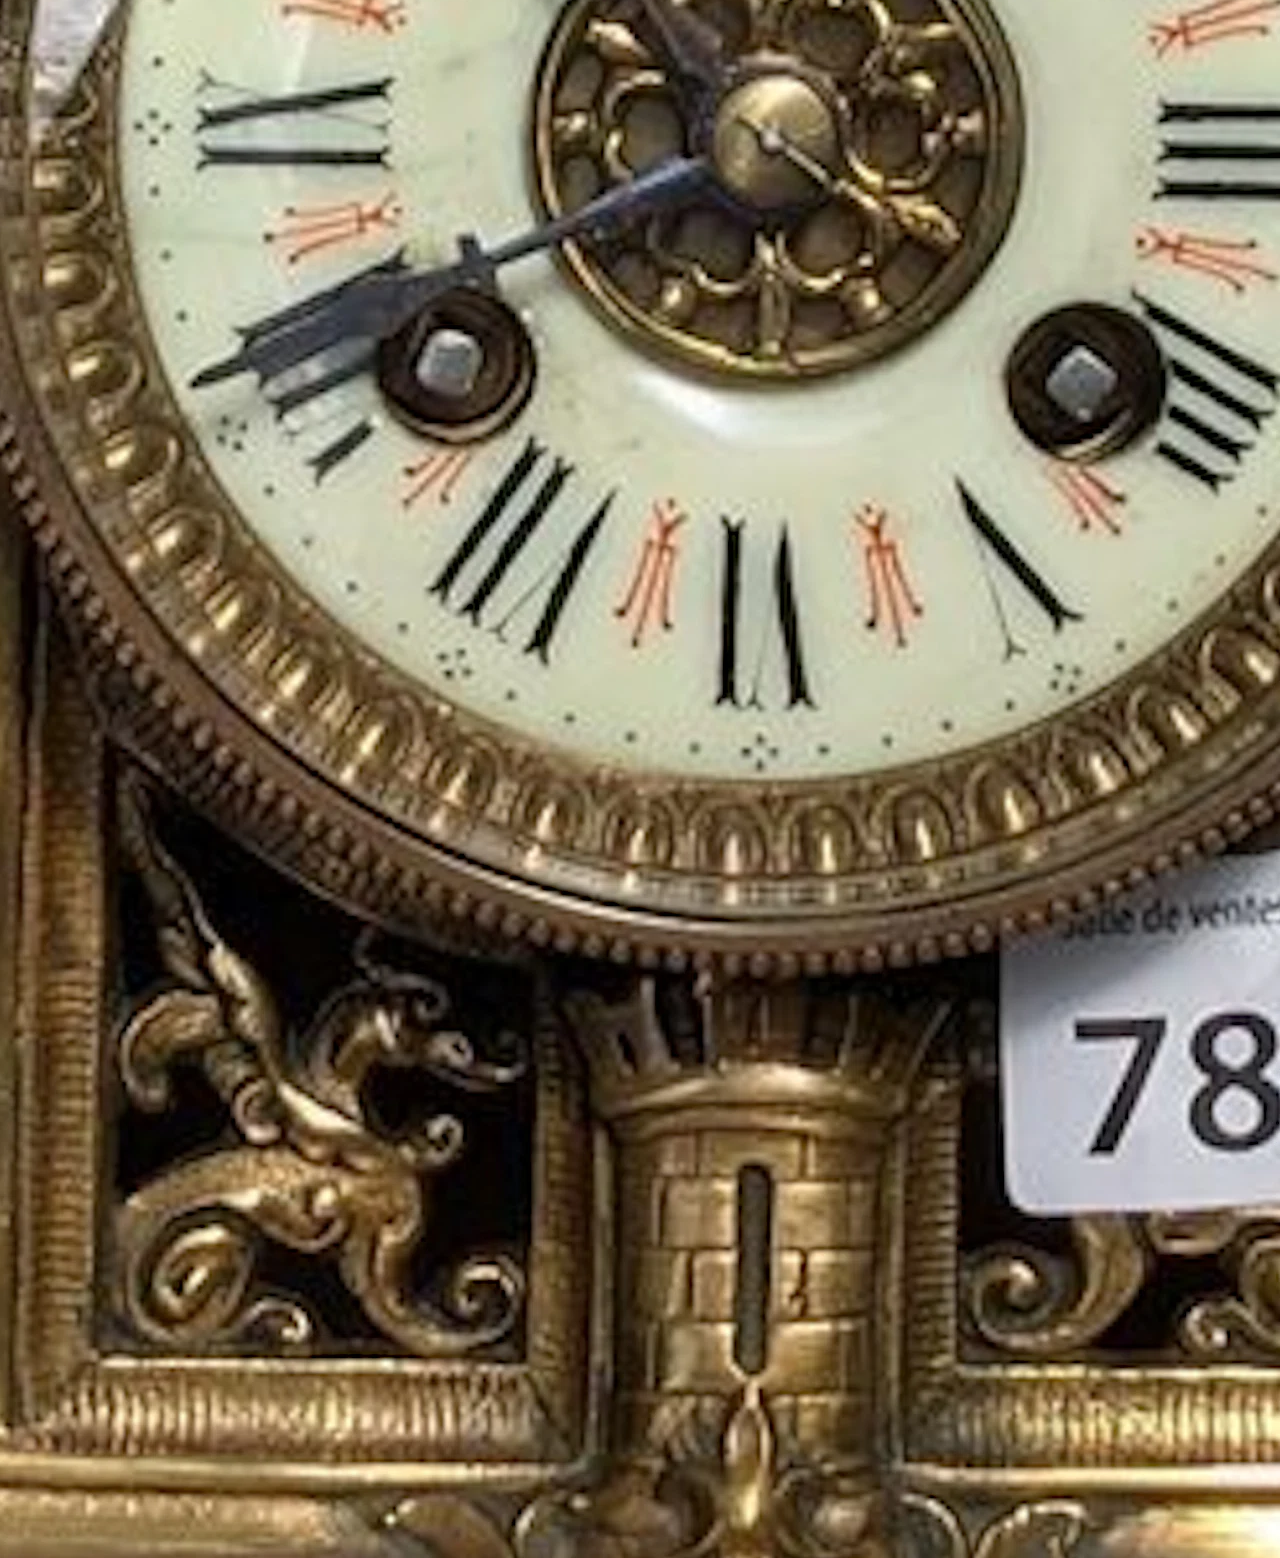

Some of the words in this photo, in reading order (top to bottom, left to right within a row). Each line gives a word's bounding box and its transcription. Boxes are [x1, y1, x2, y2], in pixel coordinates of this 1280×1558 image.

[196, 69, 396, 170] IX
[427, 435, 618, 667] VII
[715, 514, 816, 712] VI
[954, 475, 1084, 660] V
[1143, 896, 1181, 935] de
